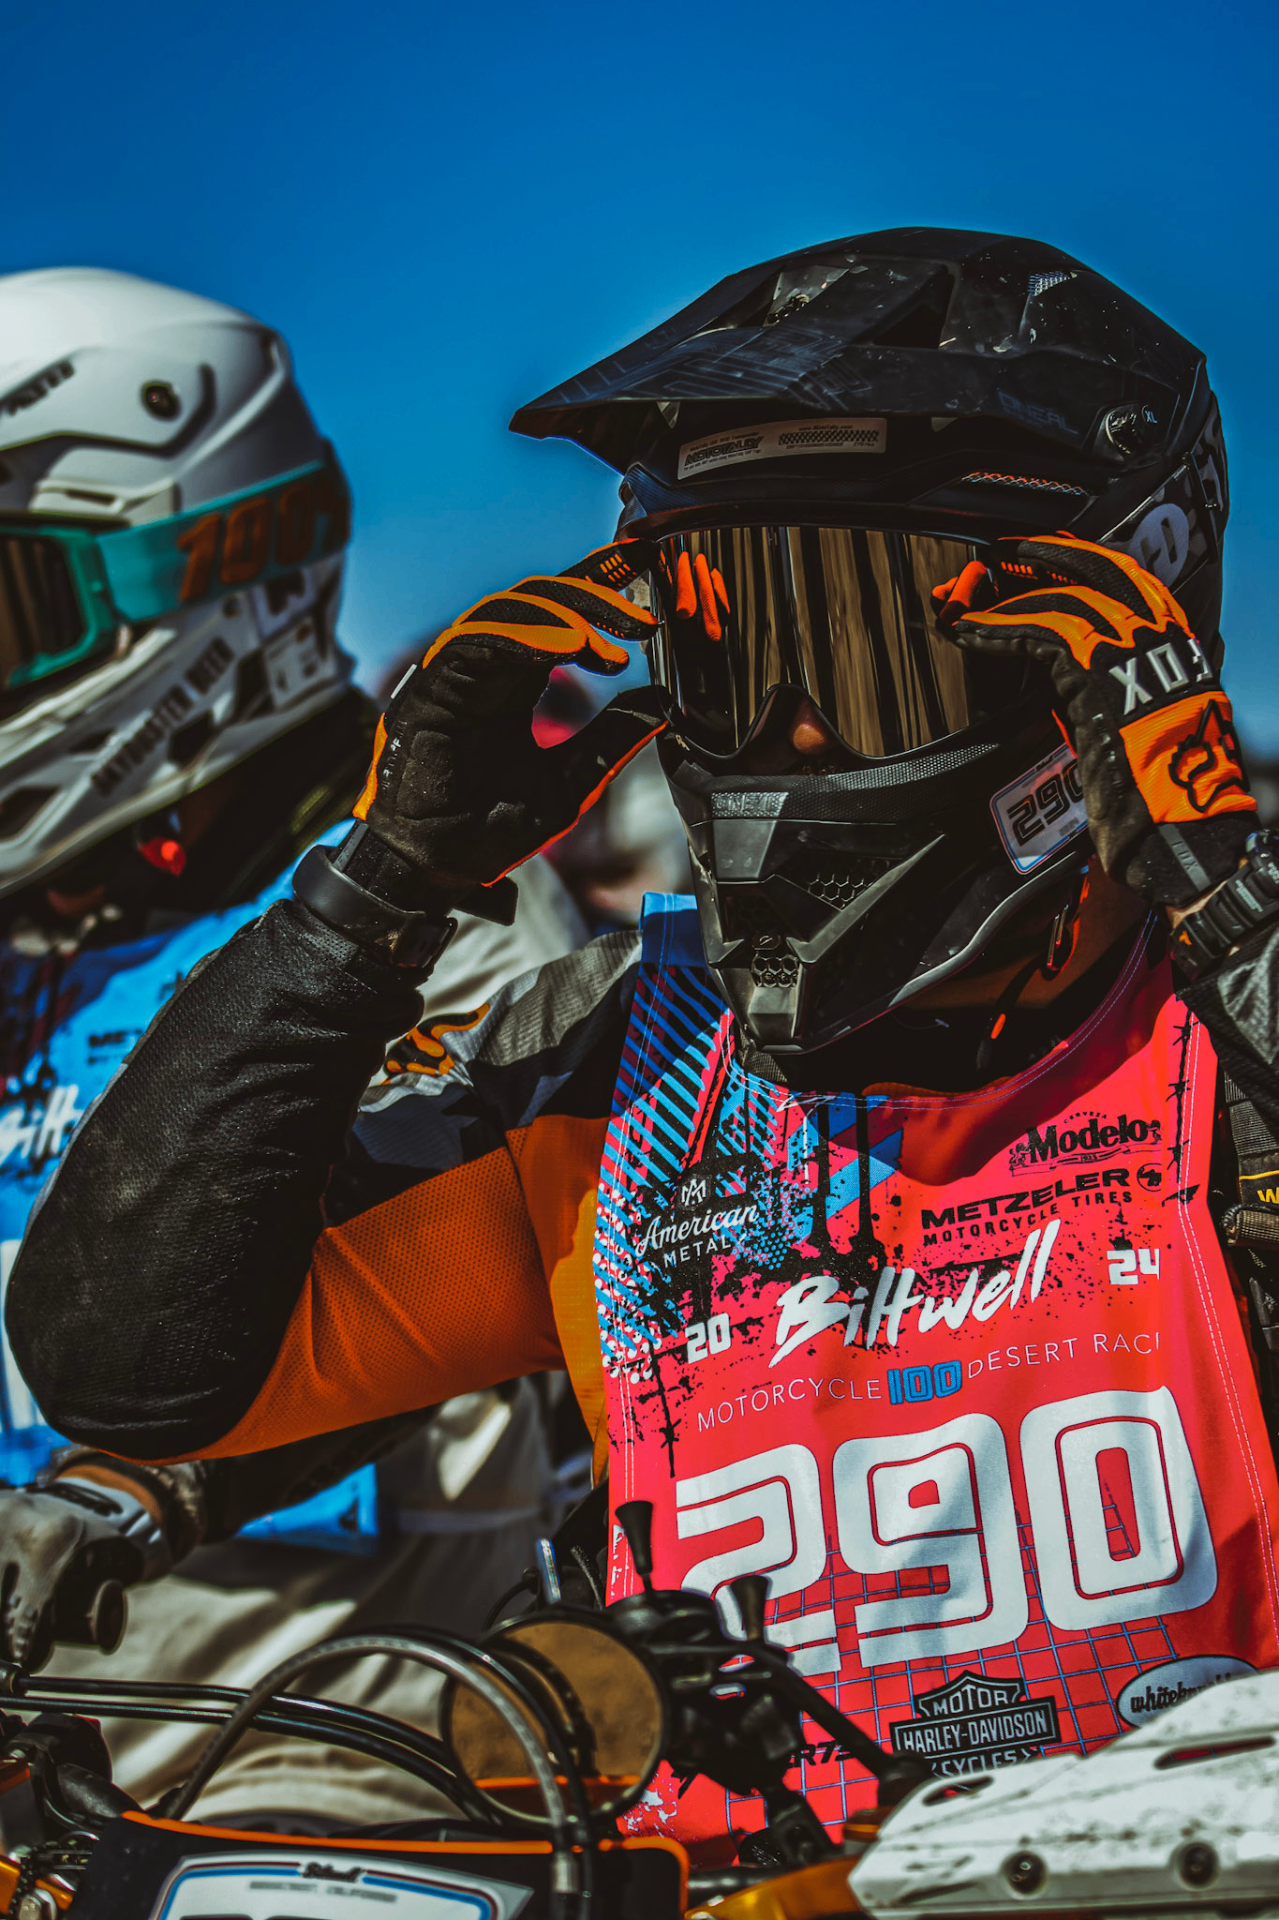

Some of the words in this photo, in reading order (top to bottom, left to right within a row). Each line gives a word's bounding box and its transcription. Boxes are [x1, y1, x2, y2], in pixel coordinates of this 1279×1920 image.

[1144, 410, 1158, 423] XL
[1007, 758, 1084, 847] 290
[1027, 1114, 1149, 1163] Modelo
[921, 1167, 1130, 1230] METZELER
[923, 1202, 1058, 1247] MOTORCYCLE
[1072, 1191, 1133, 1208] TIRES
[635, 1204, 759, 1257] American
[663, 1235, 731, 1268] METAL
[1107, 1248, 1160, 1285] 24
[768, 1219, 1062, 1368] Biltwell
[685, 1312, 731, 1364] 20
[697, 1378, 881, 1432] MOTORCYCLE
[887, 1359, 962, 1406] 100
[968, 1337, 1078, 1378] DESERT
[675, 1385, 1219, 1690] 290
[933, 1684, 1008, 1716] MOTOR
[903, 1709, 1048, 1753] HARLEY-DAVIDSON
[941, 1750, 1017, 1776] CYCLES
